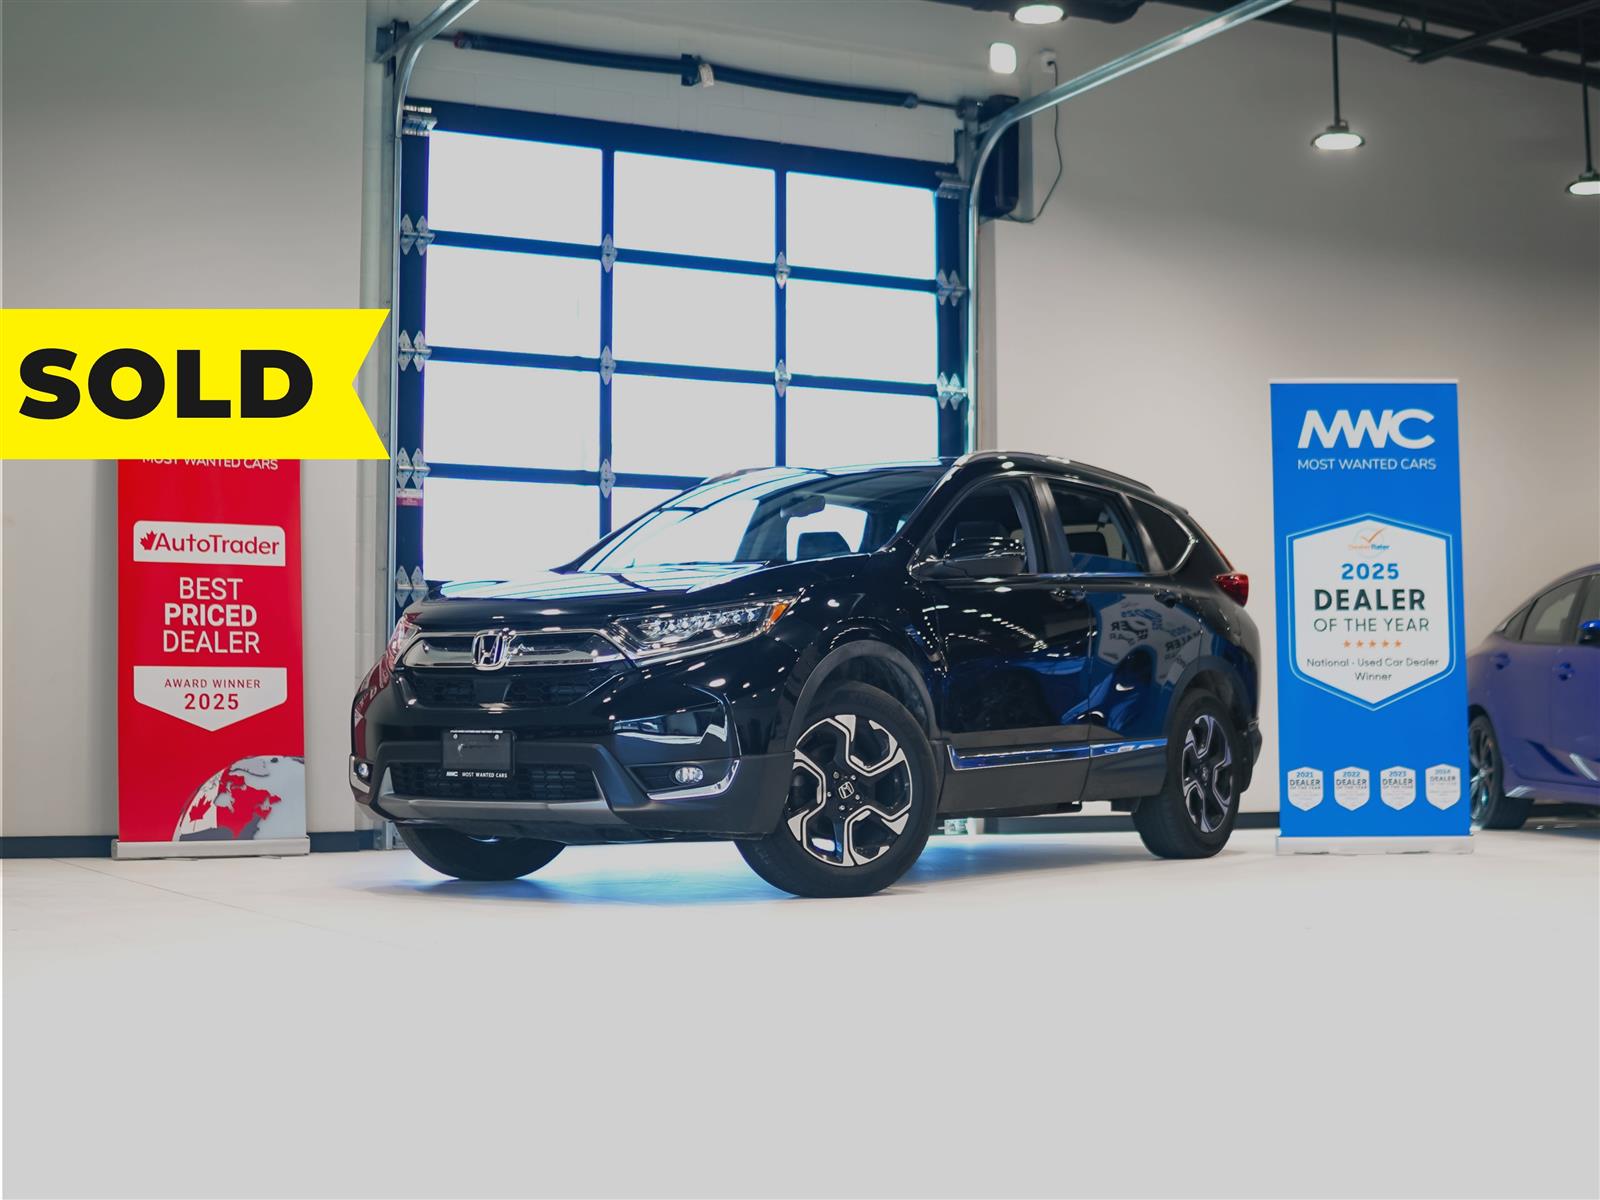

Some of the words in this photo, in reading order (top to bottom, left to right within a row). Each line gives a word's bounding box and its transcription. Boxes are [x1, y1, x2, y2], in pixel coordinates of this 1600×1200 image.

[1297, 409, 1436, 449] MWC
[243, 459, 279, 470] CARS
[1297, 458, 1335, 470] MOST
[1338, 459, 1398, 470] WANTED
[1400, 459, 1437, 470] CARS
[154, 533, 280, 555] AutoTrader
[1341, 563, 1400, 580] 2025
[179, 576, 243, 600] BEST
[1314, 588, 1426, 611] DEALER
[164, 602, 258, 627] PRICED
[1313, 618, 1338, 633] OF
[1344, 618, 1377, 632] THE
[1383, 618, 1430, 632] YEAR
[162, 629, 261, 654] DEALER
[1306, 658, 1350, 668] National
[1357, 658, 1383, 667] Used
[1385, 658, 1403, 667] Car
[1406, 657, 1439, 667] Dealer
[164, 678, 208, 688] AWARD
[212, 679, 262, 689] WINNER
[1355, 672, 1393, 681] Winner
[184, 693, 240, 710] 2025
